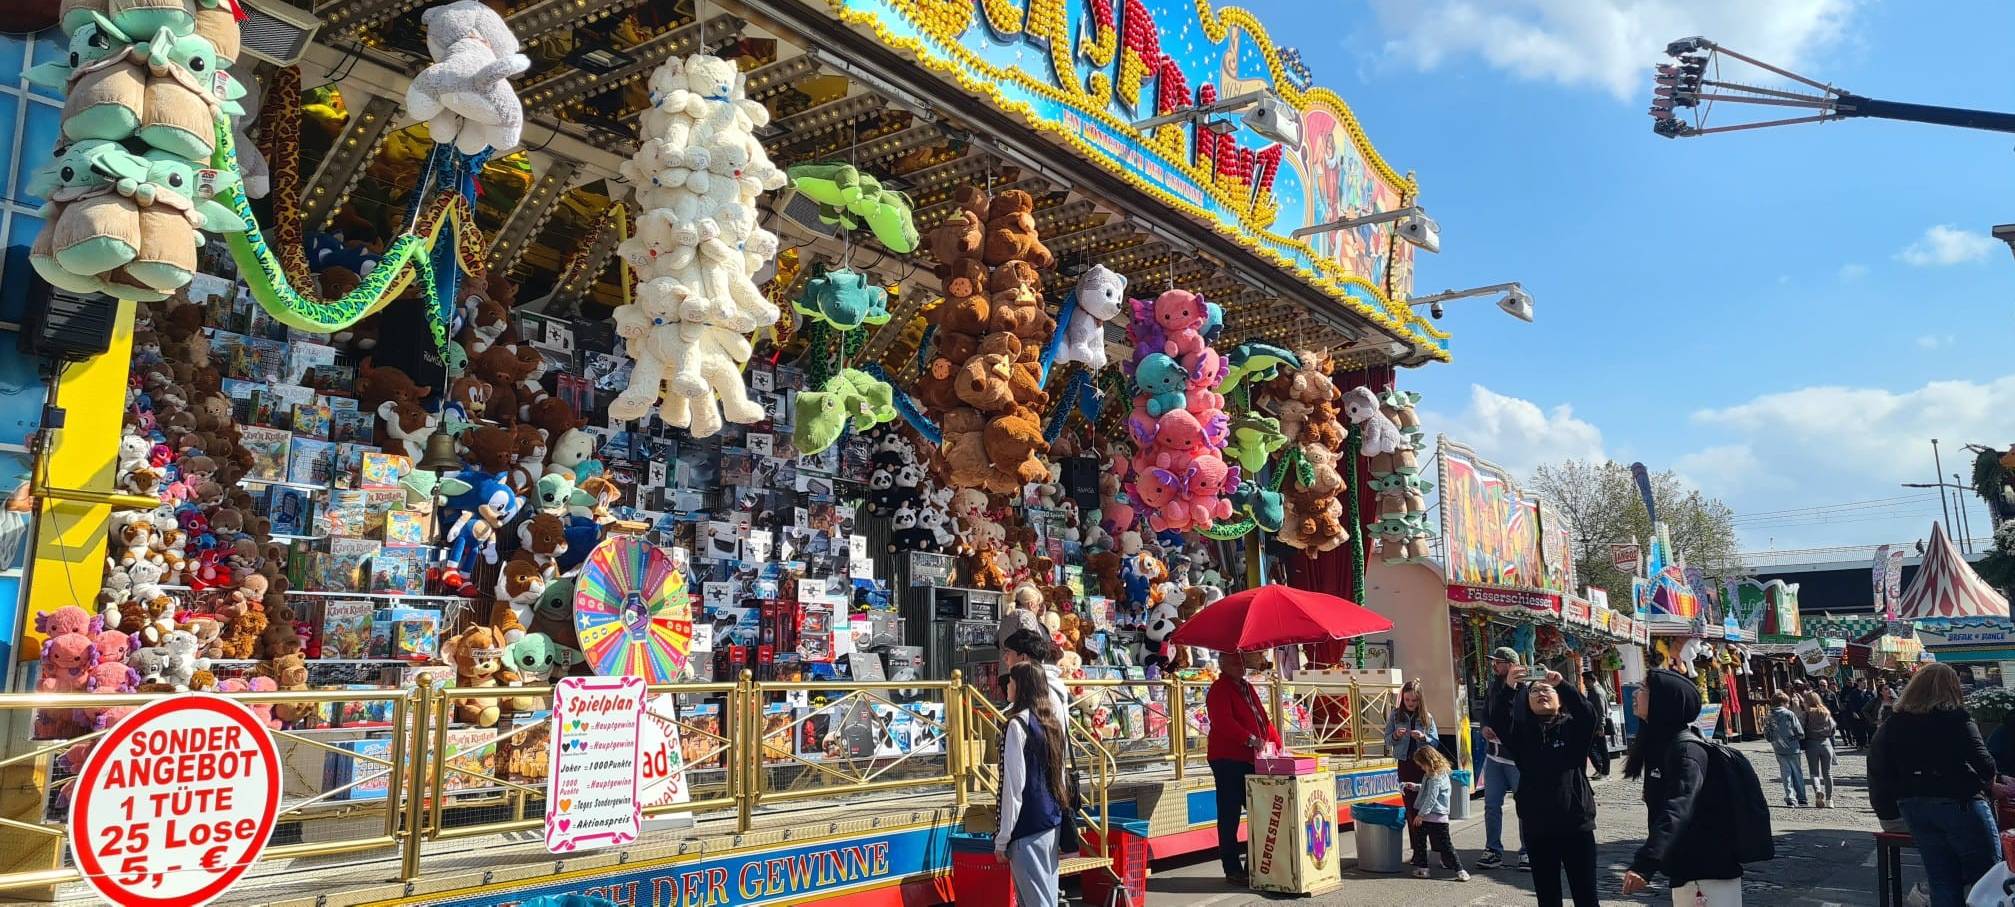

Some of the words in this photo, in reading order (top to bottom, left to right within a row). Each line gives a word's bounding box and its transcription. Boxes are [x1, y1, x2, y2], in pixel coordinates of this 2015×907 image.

[568, 694, 633, 717] Spielplan
[129, 725, 241, 757] SONDER
[103, 750, 258, 790] ANGEBOT
[560, 764, 581, 773] Joker
[120, 795, 133, 820] 1
[150, 786, 234, 817] TÜTE
[98, 822, 149, 858] 25
[164, 817, 257, 850] Lose
[118, 855, 182, 889] 5,-
[198, 845, 228, 874] €
[650, 866, 730, 907] DER
[738, 841, 889, 900] GEWINNE
